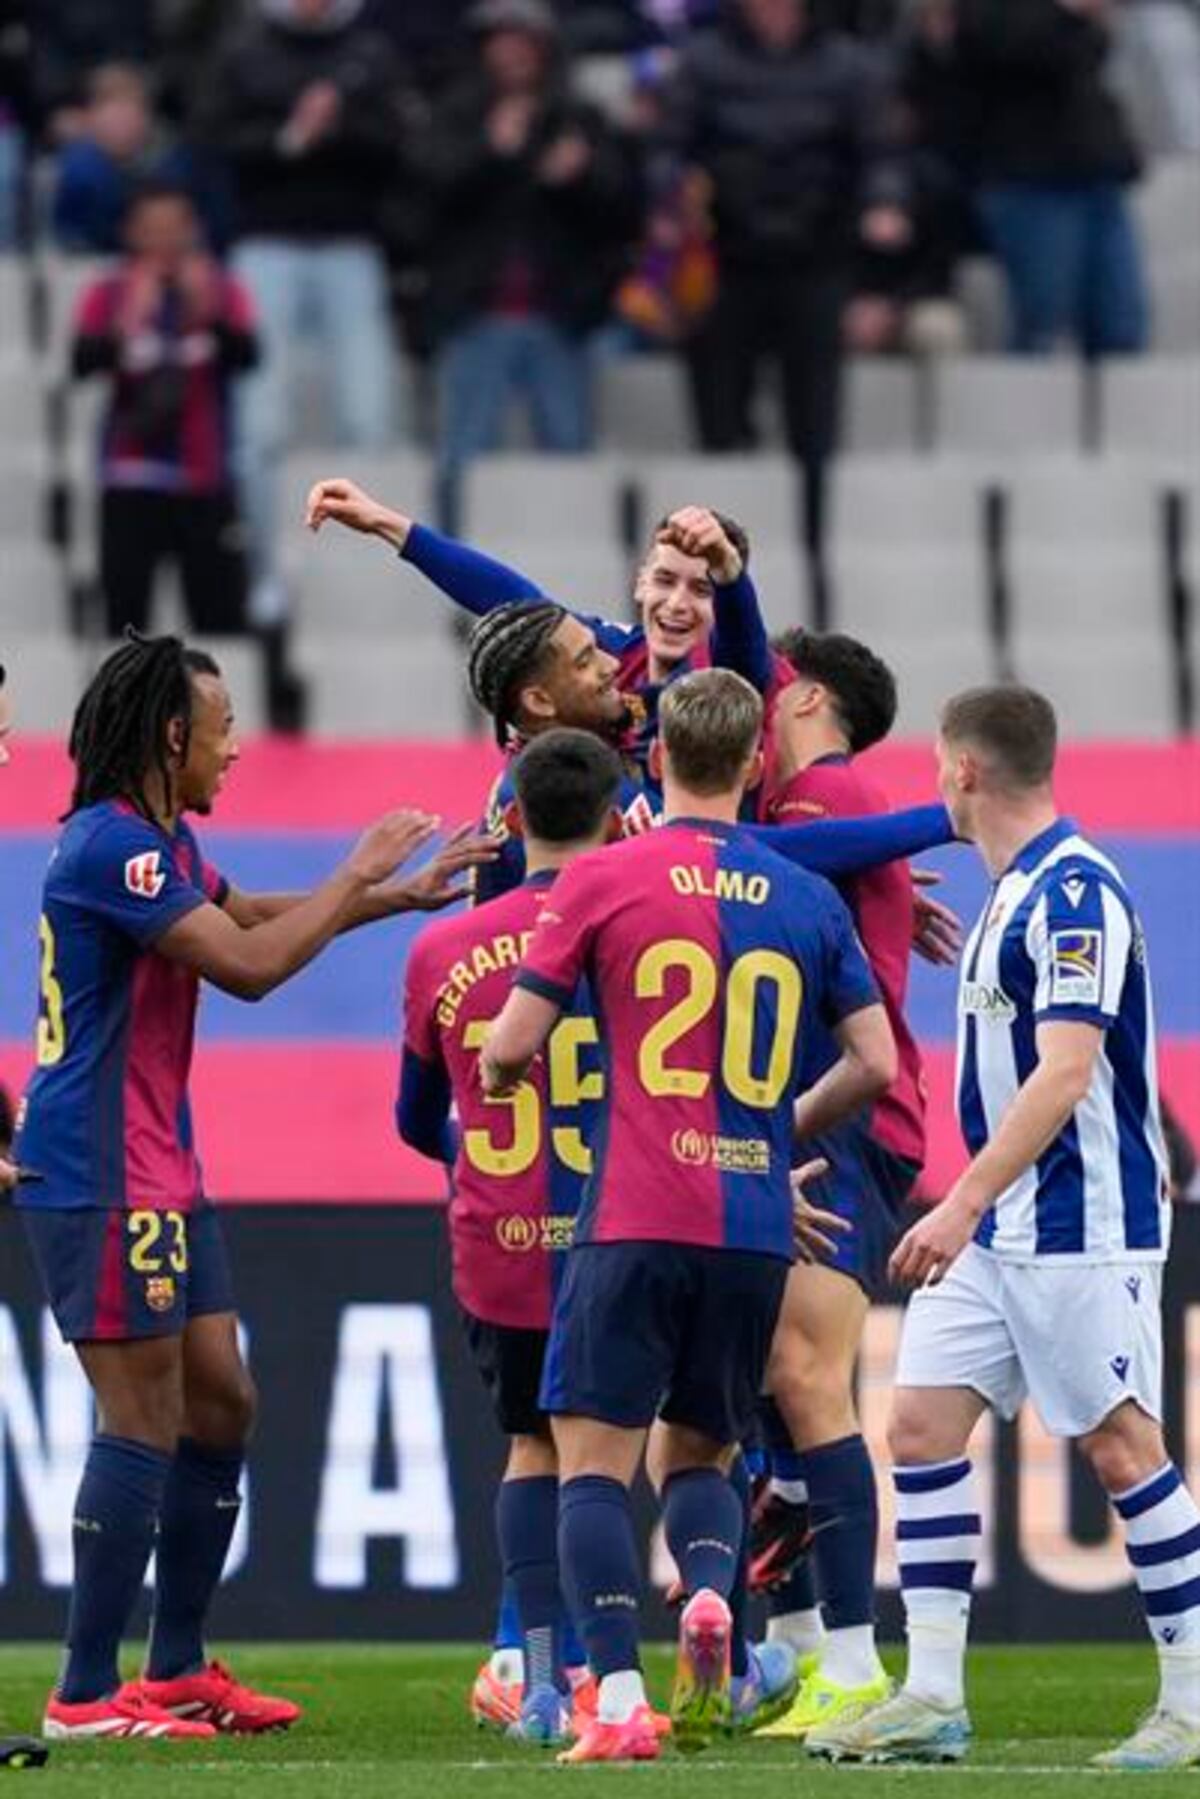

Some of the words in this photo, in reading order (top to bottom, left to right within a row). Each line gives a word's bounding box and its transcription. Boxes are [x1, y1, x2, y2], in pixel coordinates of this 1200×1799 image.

[669, 865, 770, 905] OLMO
[635, 938, 803, 1109] 20
[462, 1017, 604, 1176] 35
[127, 1210, 188, 1272] 23
